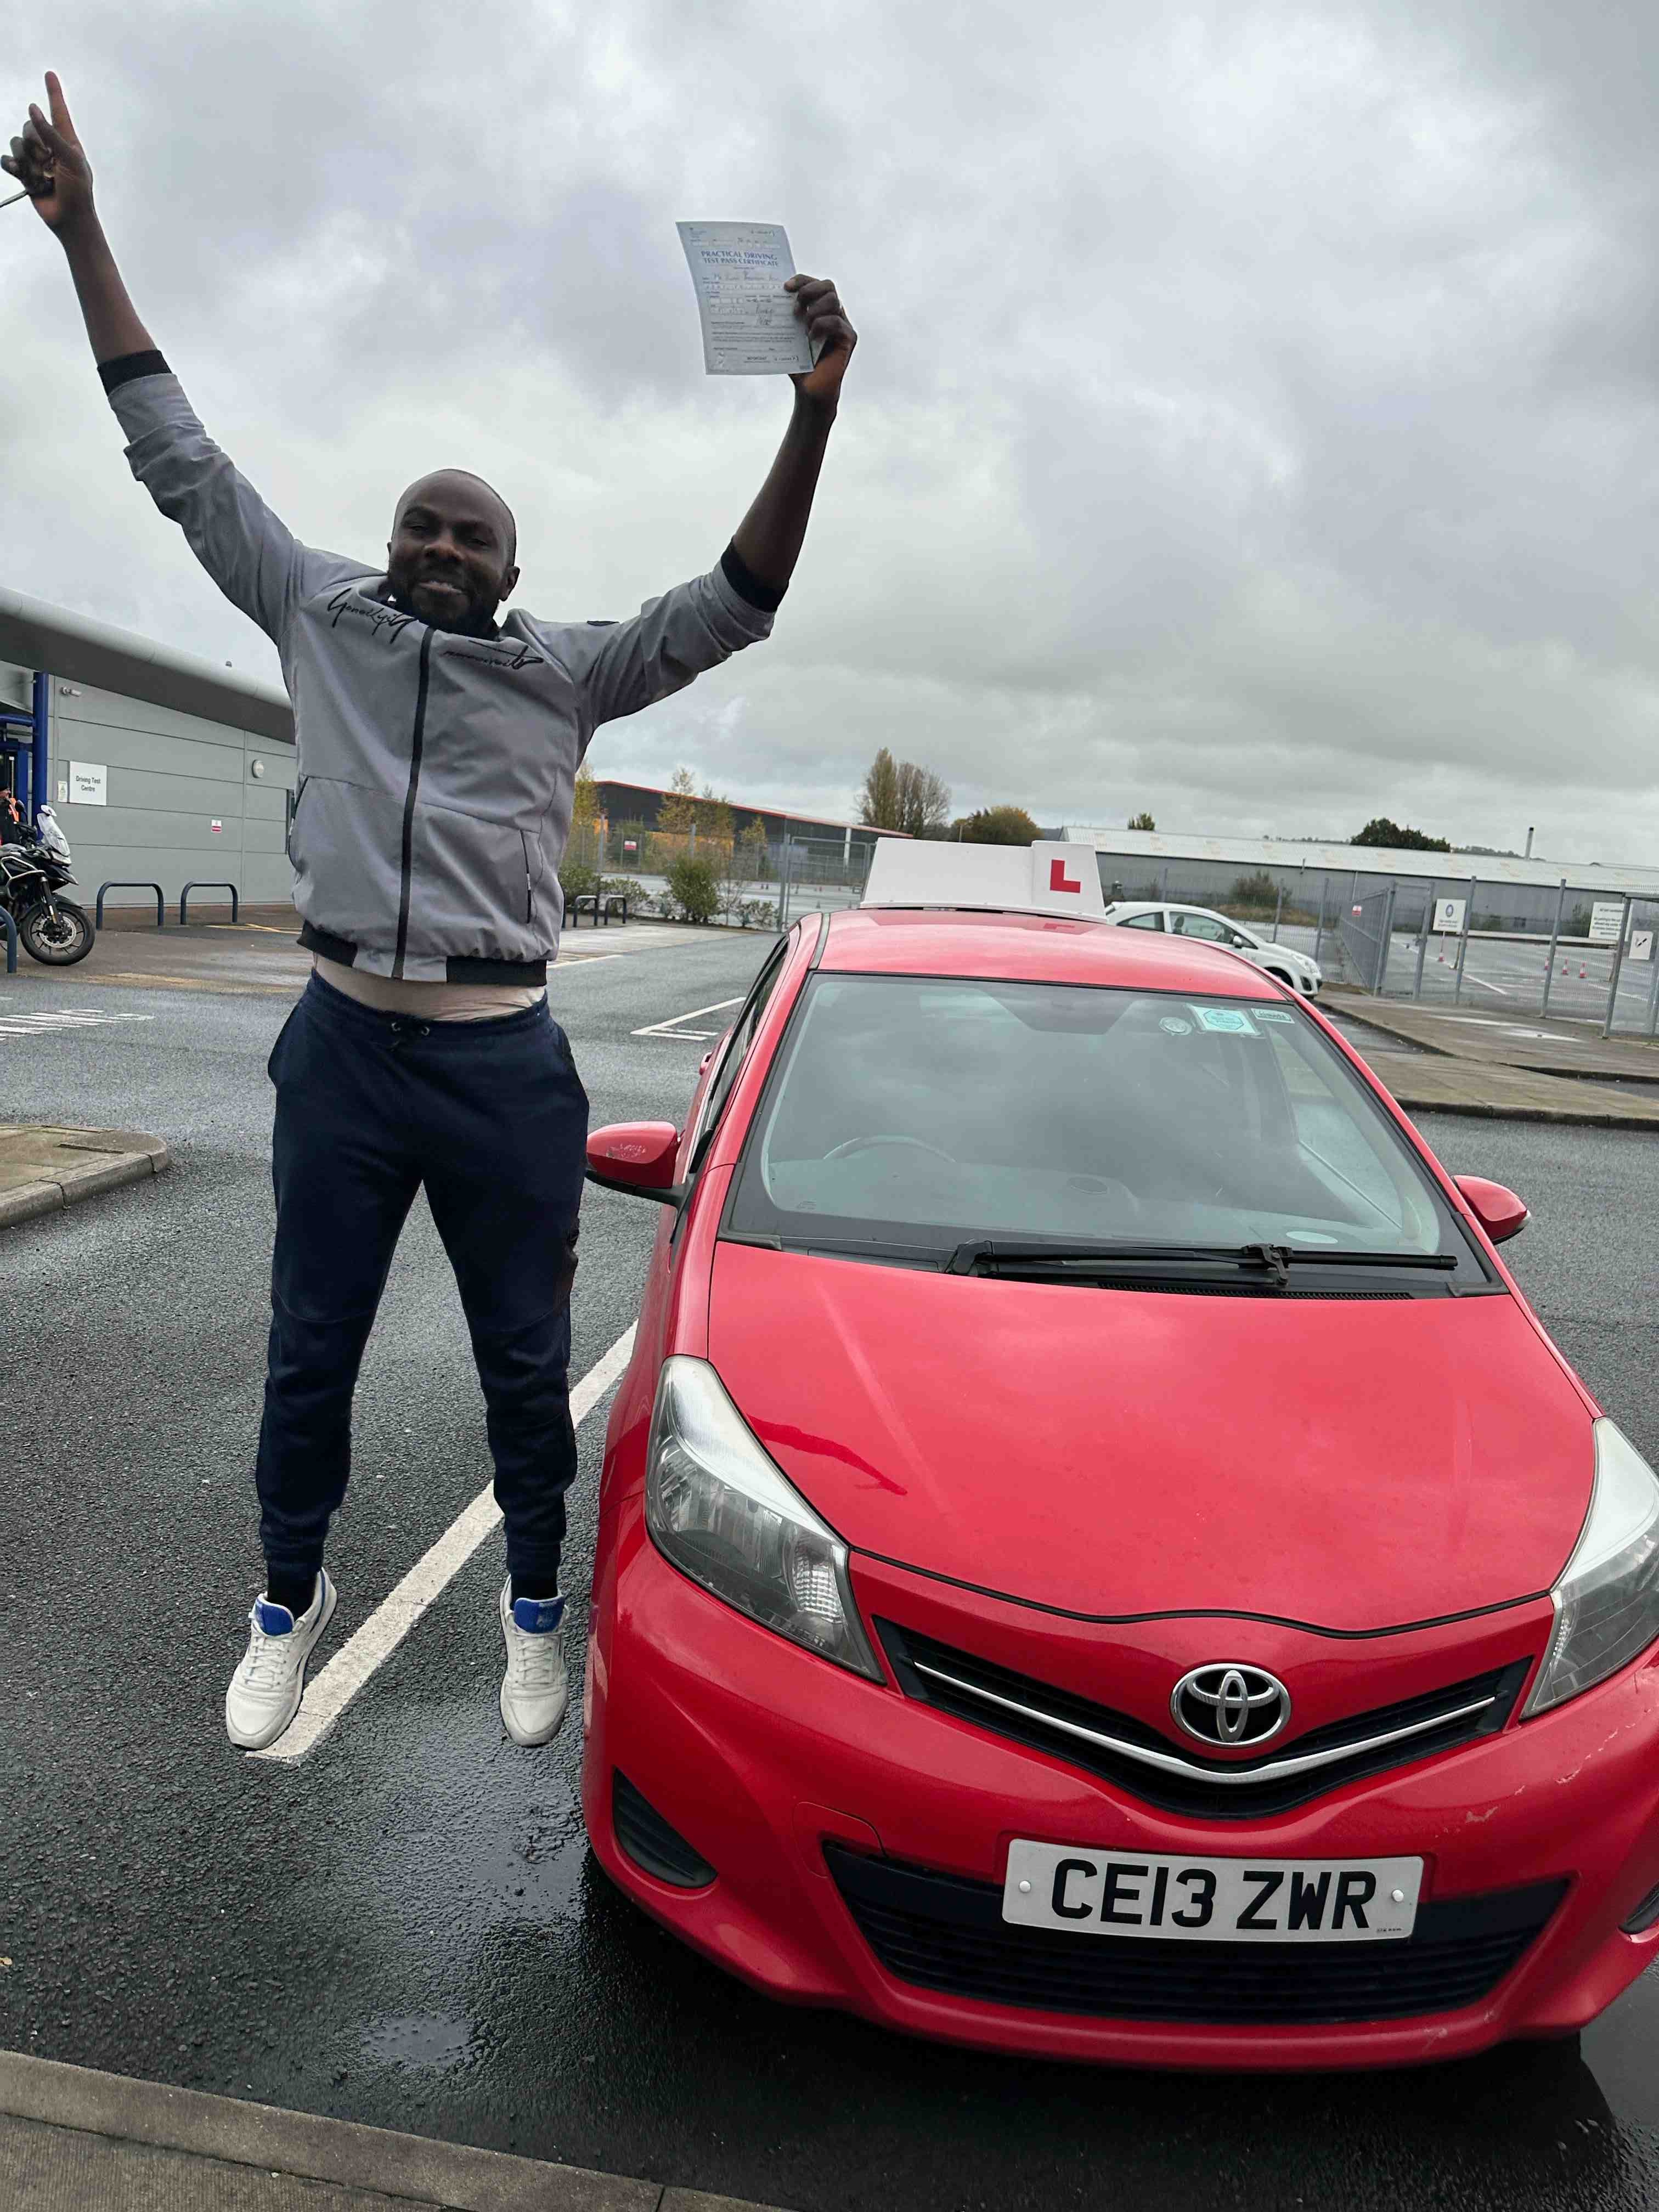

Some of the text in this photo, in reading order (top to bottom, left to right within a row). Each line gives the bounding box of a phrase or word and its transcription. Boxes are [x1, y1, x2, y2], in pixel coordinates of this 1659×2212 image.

[701, 250, 777, 260] PRACTICAL DRIVING
[738, 258, 778, 267] CERTIFICATE
[76, 775, 91, 784] Driving
[1049, 859, 1081, 894] L
[1051, 1858, 1378, 1931] CE13 ZWR
